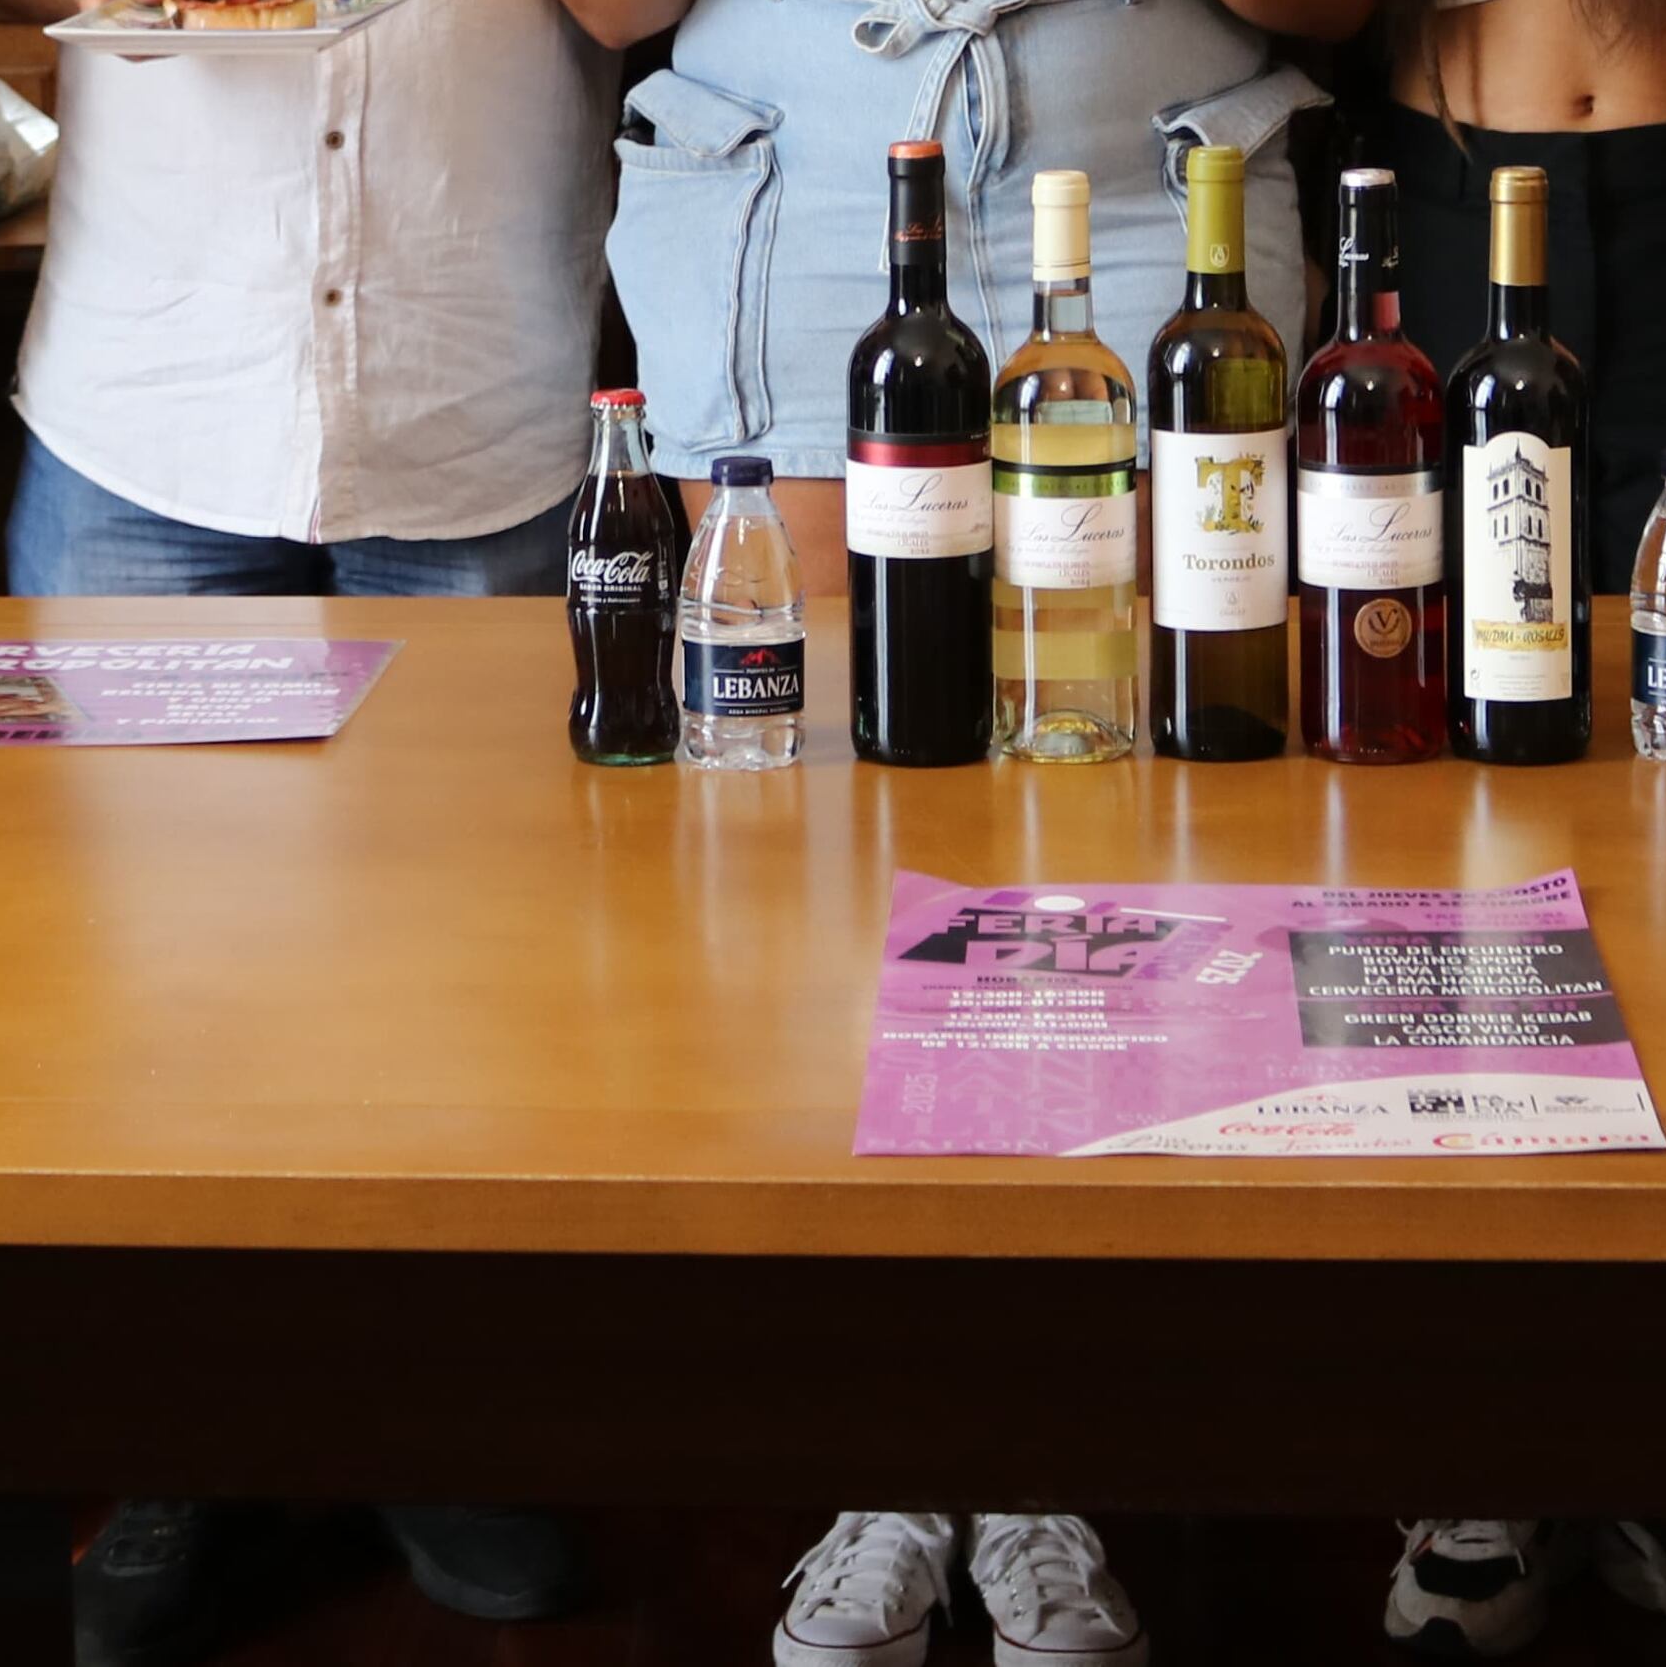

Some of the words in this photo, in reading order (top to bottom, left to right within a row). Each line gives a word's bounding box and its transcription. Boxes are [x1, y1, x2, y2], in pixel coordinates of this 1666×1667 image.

[889, 473, 969, 512] Luceras
[1050, 502, 1125, 543] Luceras
[1358, 502, 1433, 542] Luceras
[572, 549, 653, 584] Coca-Cola
[1182, 553, 1275, 571] Torondos
[712, 672, 800, 700] LEBANZA
[941, 914, 1156, 935] FERIA
[1328, 945, 1398, 956] PUNTO
[1407, 945, 1434, 956] DE
[1441, 944, 1564, 956] ENCUENTRO
[1362, 956, 1463, 966] BOWLING
[1467, 955, 1534, 966] SPORT
[1363, 966, 1433, 976] NUEVA
[1441, 965, 1539, 976] ESSENCIA
[1364, 976, 1390, 986] LA
[1397, 976, 1543, 986] MALHABLADA
[1440, 980, 1603, 996] METROPOLITAN
[1344, 1013, 1415, 1024] GREEN
[1423, 1013, 1515, 1024] DORNER
[1521, 1010, 1593, 1024] KEBAB
[1402, 1024, 1472, 1035] CASCO
[1479, 1024, 1541, 1035] VIEJO
[1373, 1035, 1401, 1046] LA
[1408, 1035, 1575, 1046] COMANDANCIA
